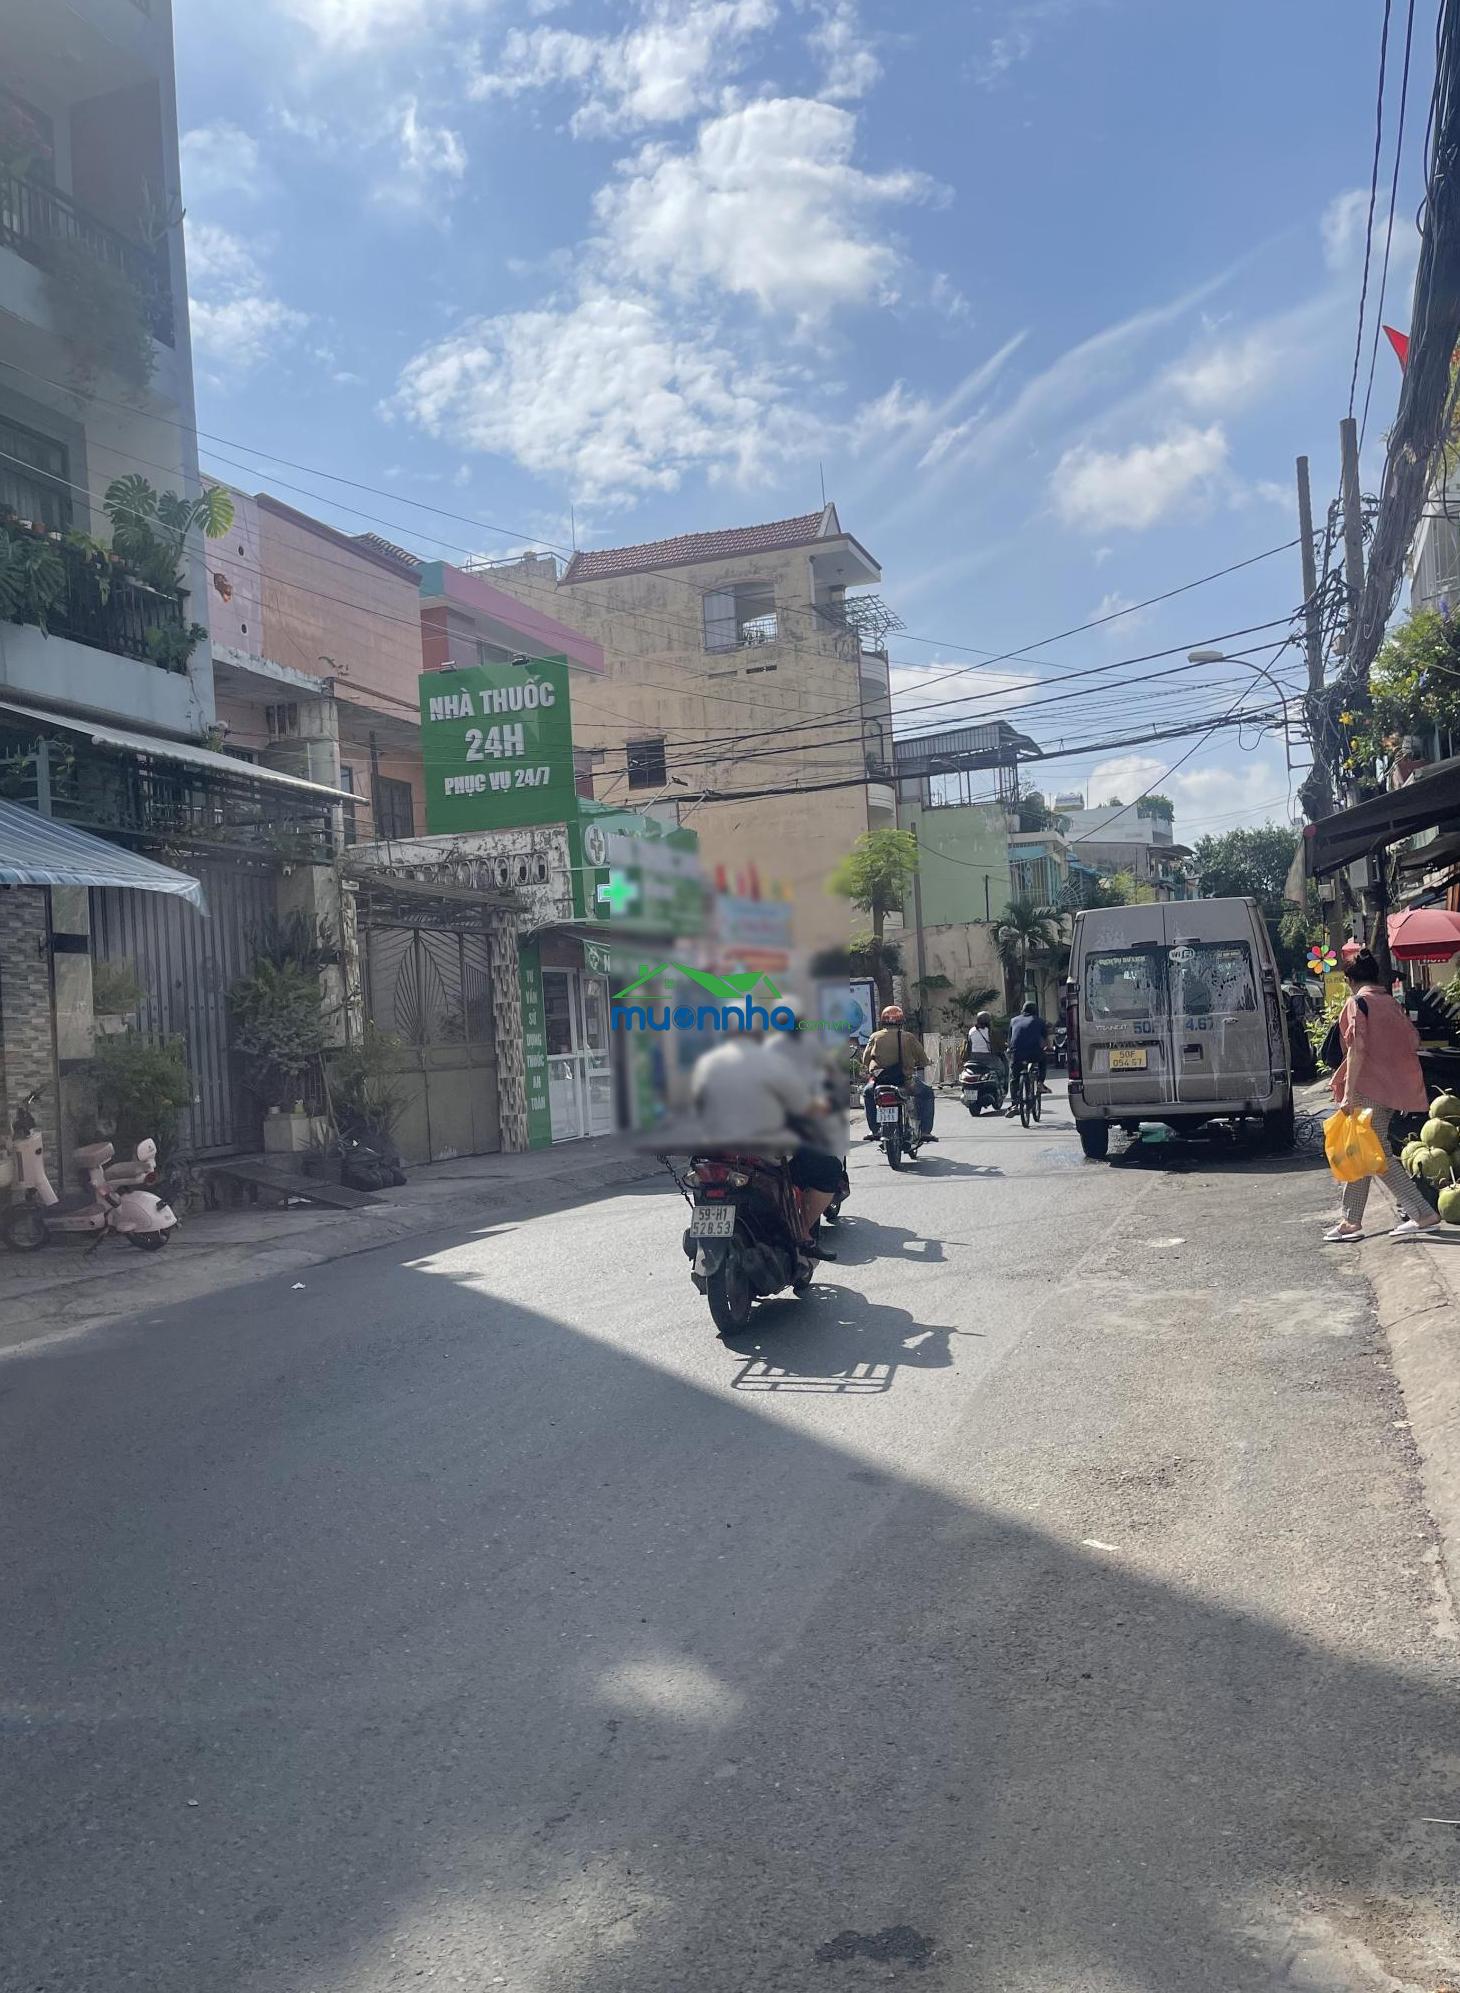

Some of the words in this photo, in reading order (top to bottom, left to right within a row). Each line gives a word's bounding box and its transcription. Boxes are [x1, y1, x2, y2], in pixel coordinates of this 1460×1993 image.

[429, 687, 476, 721] NHÀ
[479, 675, 556, 715] THUỐC
[465, 723, 525, 761] 24H
[444, 774, 487, 797] PHỤC
[489, 771, 512, 793] VỤ
[514, 766, 551, 788] 24/7
[1119, 1050, 1137, 1059] 50F
[699, 1208, 727, 1221] 59-H1
